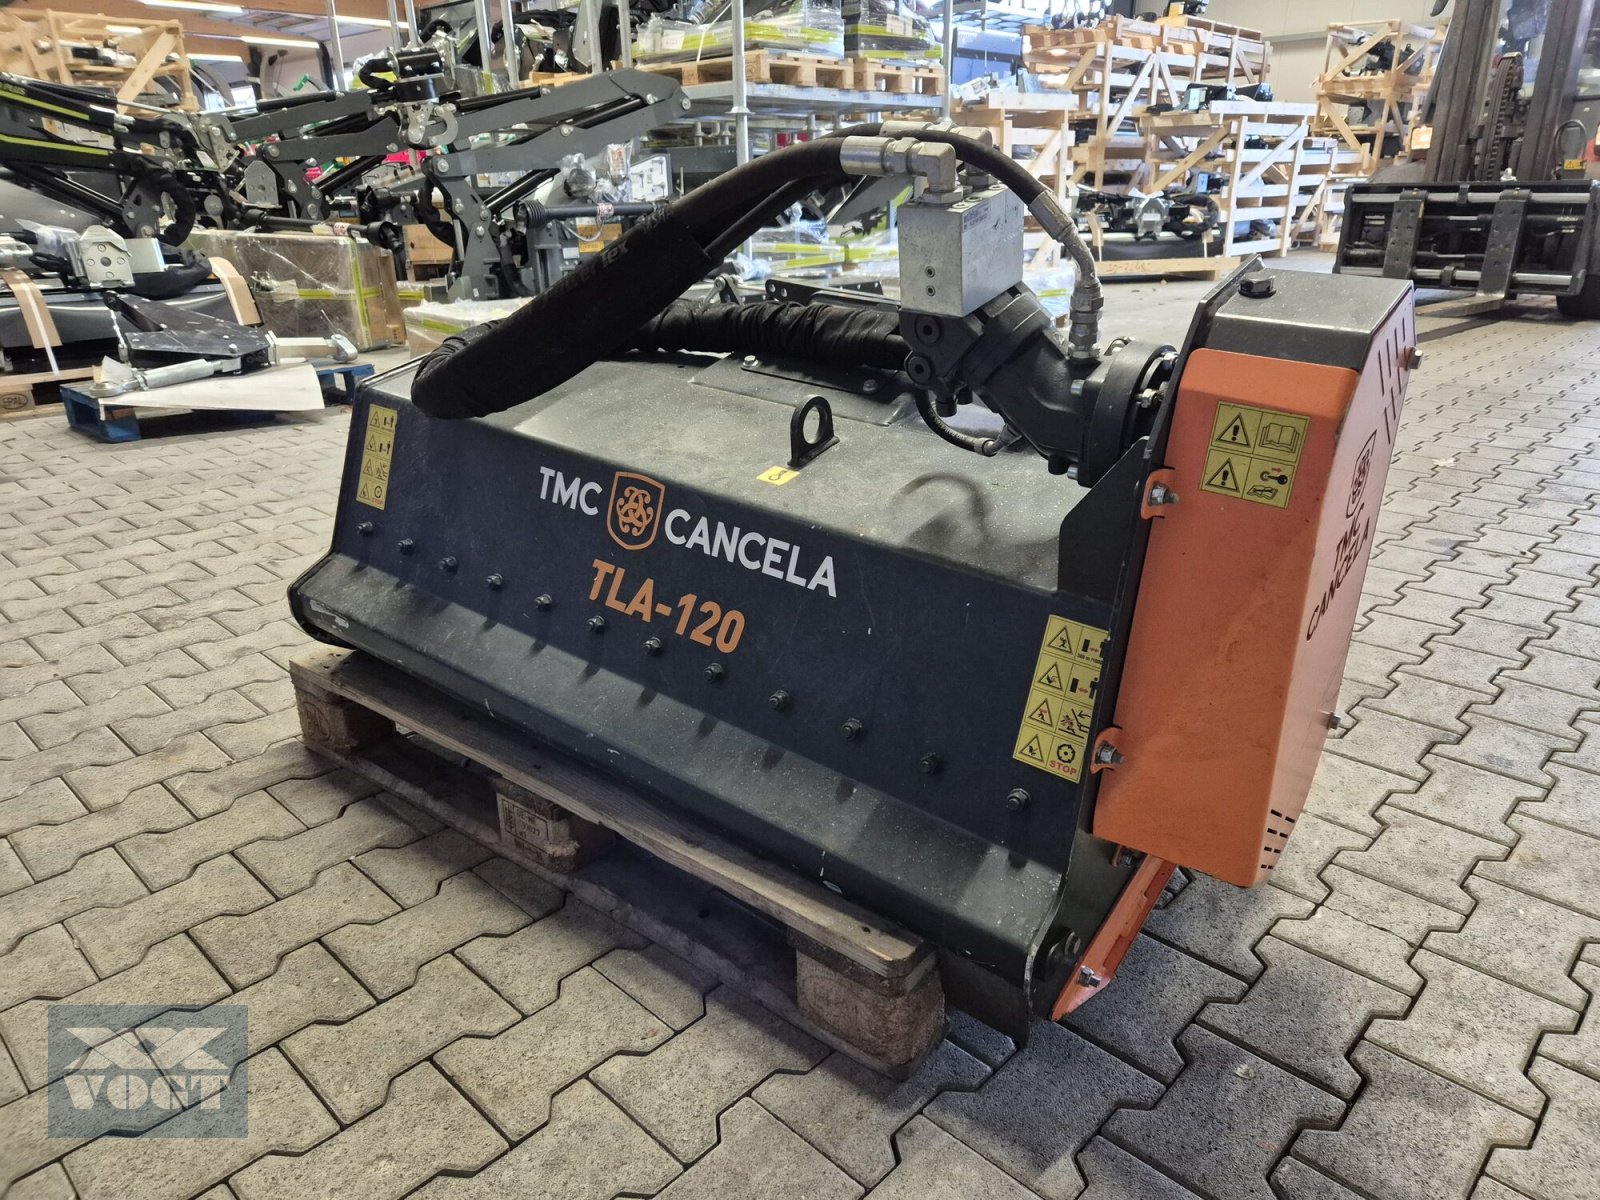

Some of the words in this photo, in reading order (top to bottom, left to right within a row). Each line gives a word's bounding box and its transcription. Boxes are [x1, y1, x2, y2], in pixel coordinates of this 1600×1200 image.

[539, 465, 602, 517] TMC
[664, 508, 837, 599] CANCELA
[1306, 517, 1370, 641] CANCELA
[1334, 502, 1365, 572] TMC
[588, 558, 745, 654] TLA-120
[1049, 759, 1077, 775] STOP
